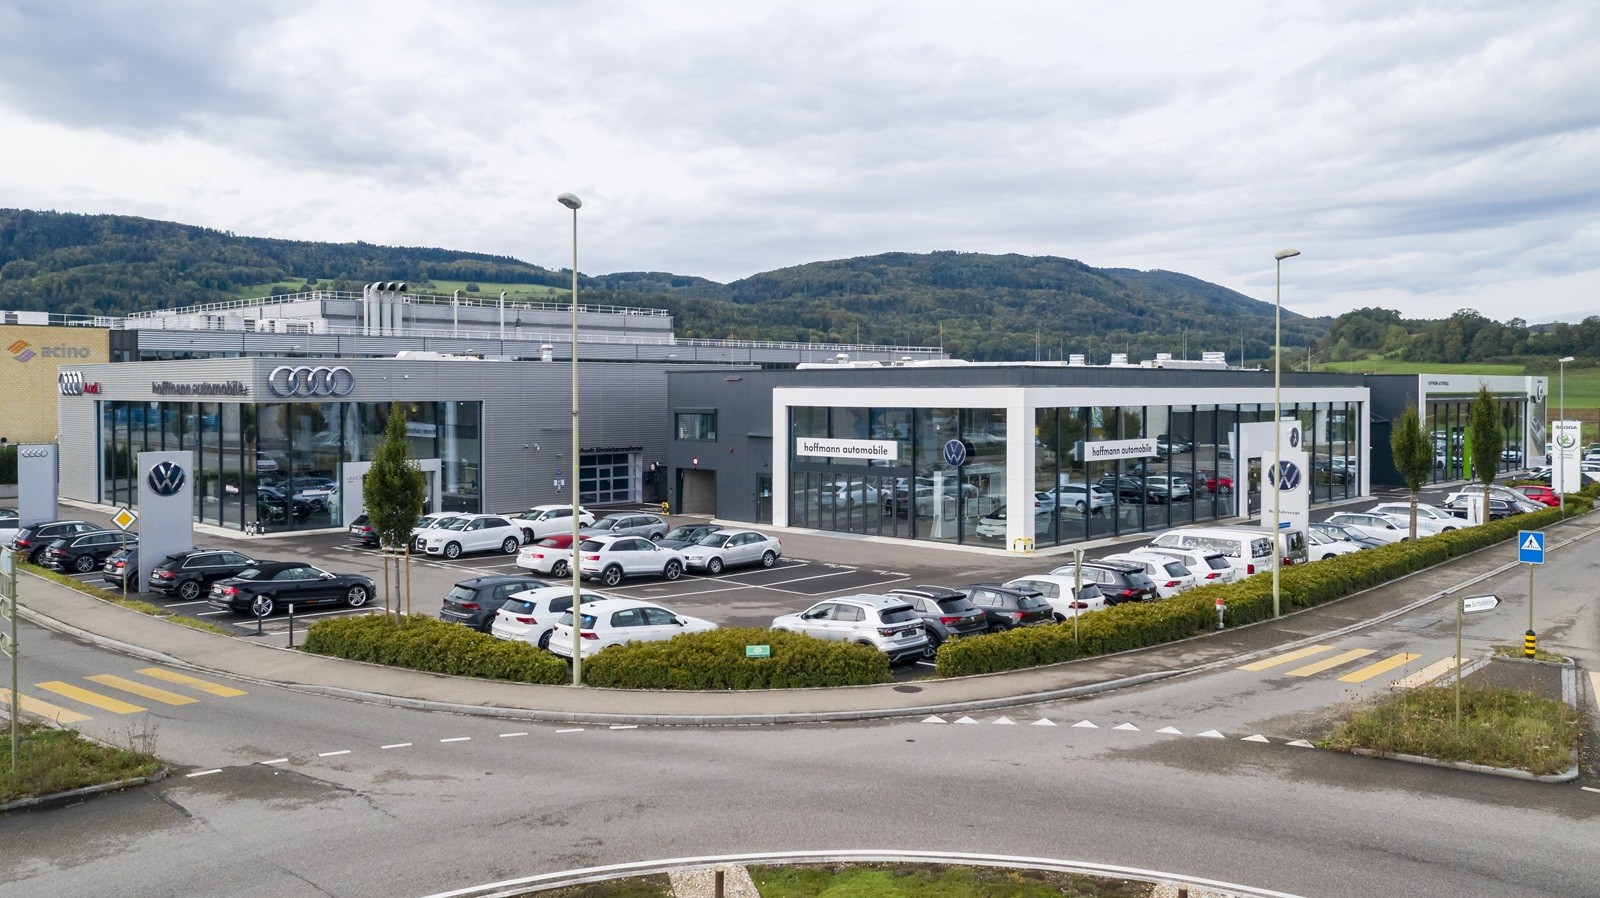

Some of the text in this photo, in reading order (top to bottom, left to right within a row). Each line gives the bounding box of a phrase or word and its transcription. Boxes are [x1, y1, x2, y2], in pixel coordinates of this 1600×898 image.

[41, 343, 90, 358] acino
[83, 382, 101, 394] Audi
[152, 381, 247, 395] hoffmann automobile
[804, 443, 888, 456] hoffmann automobile
[943, 439, 966, 467] VW
[1092, 443, 1152, 456] hoffmann automobile
[147, 461, 186, 497] VW
